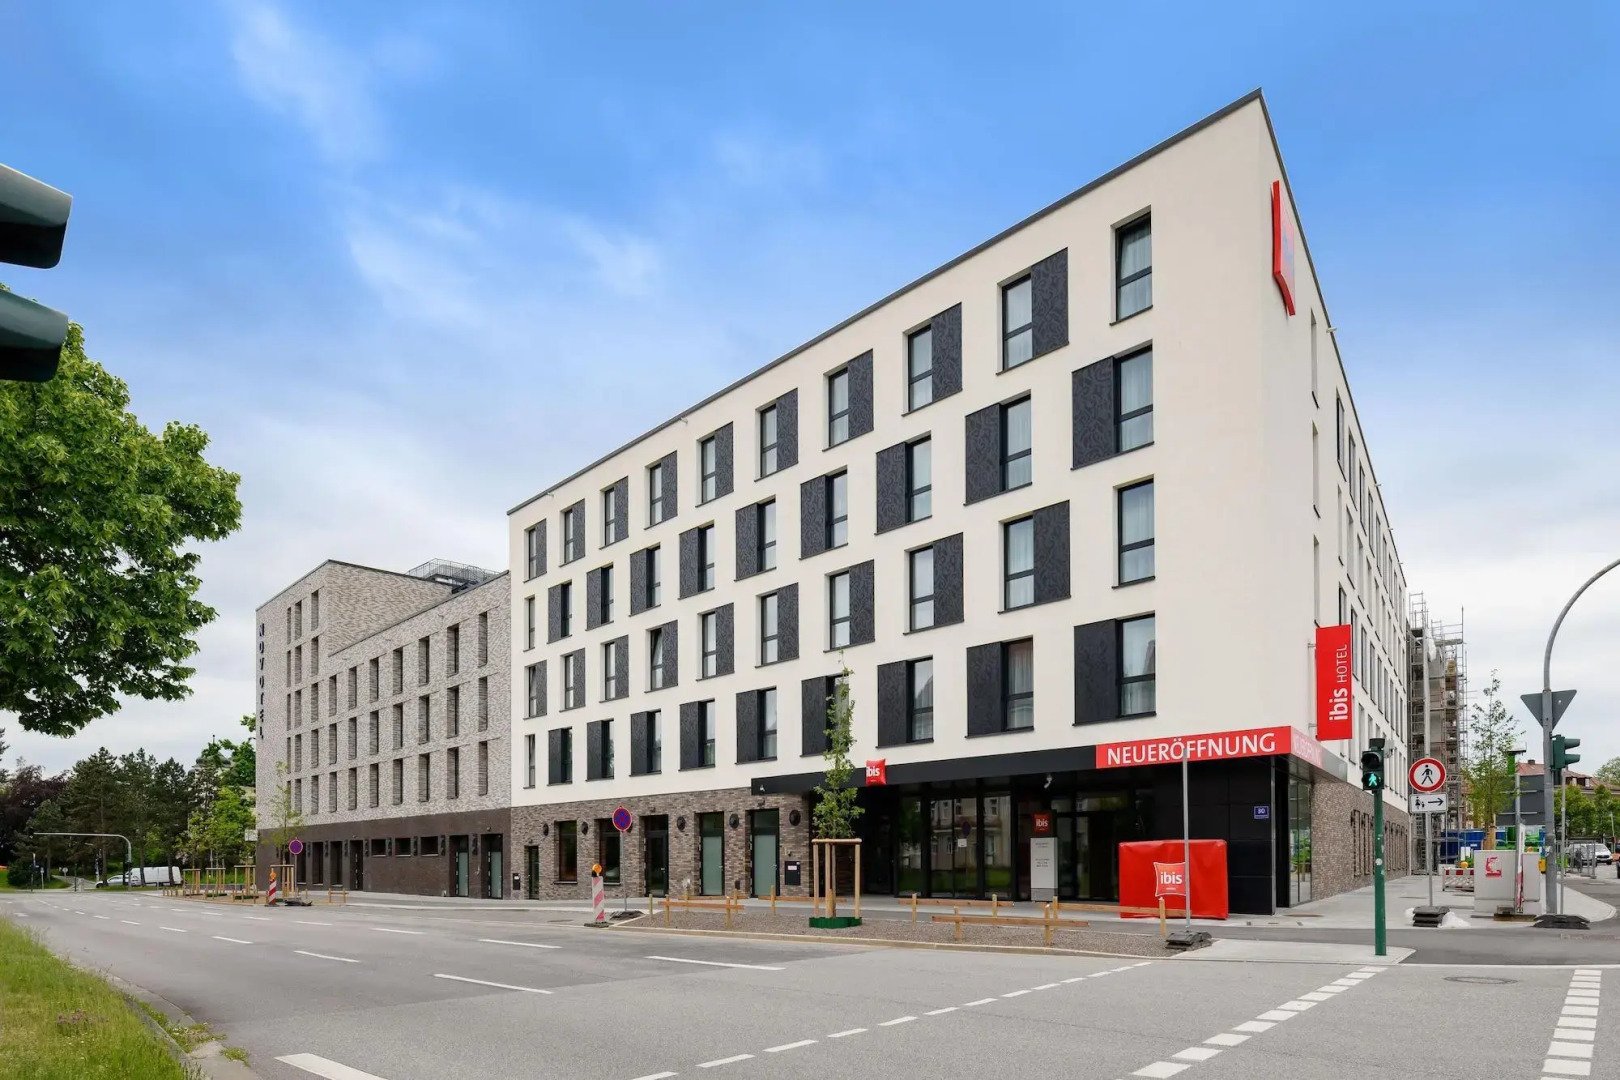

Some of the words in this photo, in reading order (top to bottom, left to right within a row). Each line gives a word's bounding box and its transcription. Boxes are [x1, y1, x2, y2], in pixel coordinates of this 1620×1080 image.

[1336, 644, 1348, 683] HOTEL
[1329, 688, 1348, 720] ibis
[1107, 732, 1275, 765] NEUERÖFFNUNG
[866, 766, 880, 777] ibis
[1036, 818, 1049, 827] ibis
[1160, 872, 1182, 884] ibis
